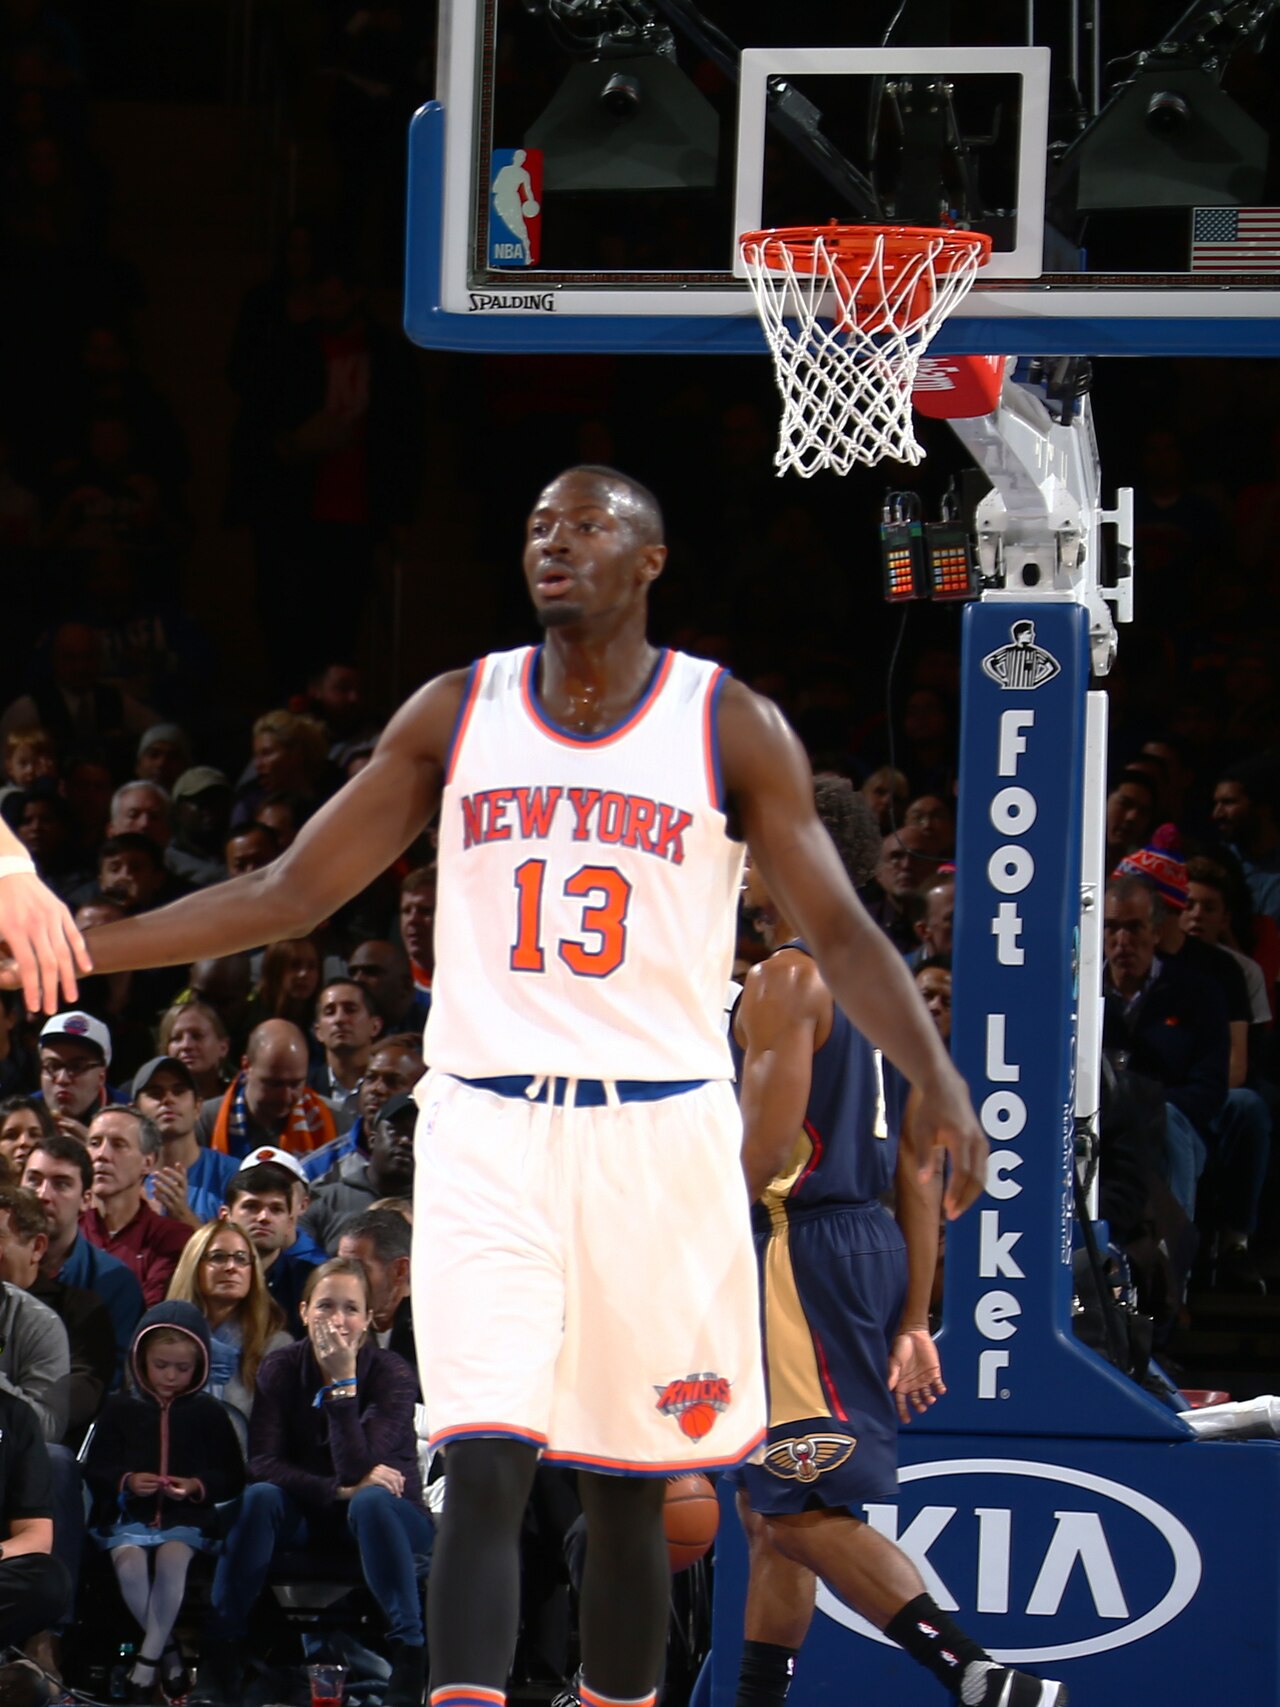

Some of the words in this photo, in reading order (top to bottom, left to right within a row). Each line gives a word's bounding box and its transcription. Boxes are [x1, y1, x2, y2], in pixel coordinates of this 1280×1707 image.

[469, 293, 556, 311] SPALDING
[494, 244, 523, 259] NBA
[461, 786, 563, 850] NEW
[566, 788, 693, 866] YORK
[987, 710, 1037, 965] Foot
[510, 858, 632, 979] 13
[974, 1014, 1027, 1399] Locker
[862, 1504, 1129, 1618] KIA
